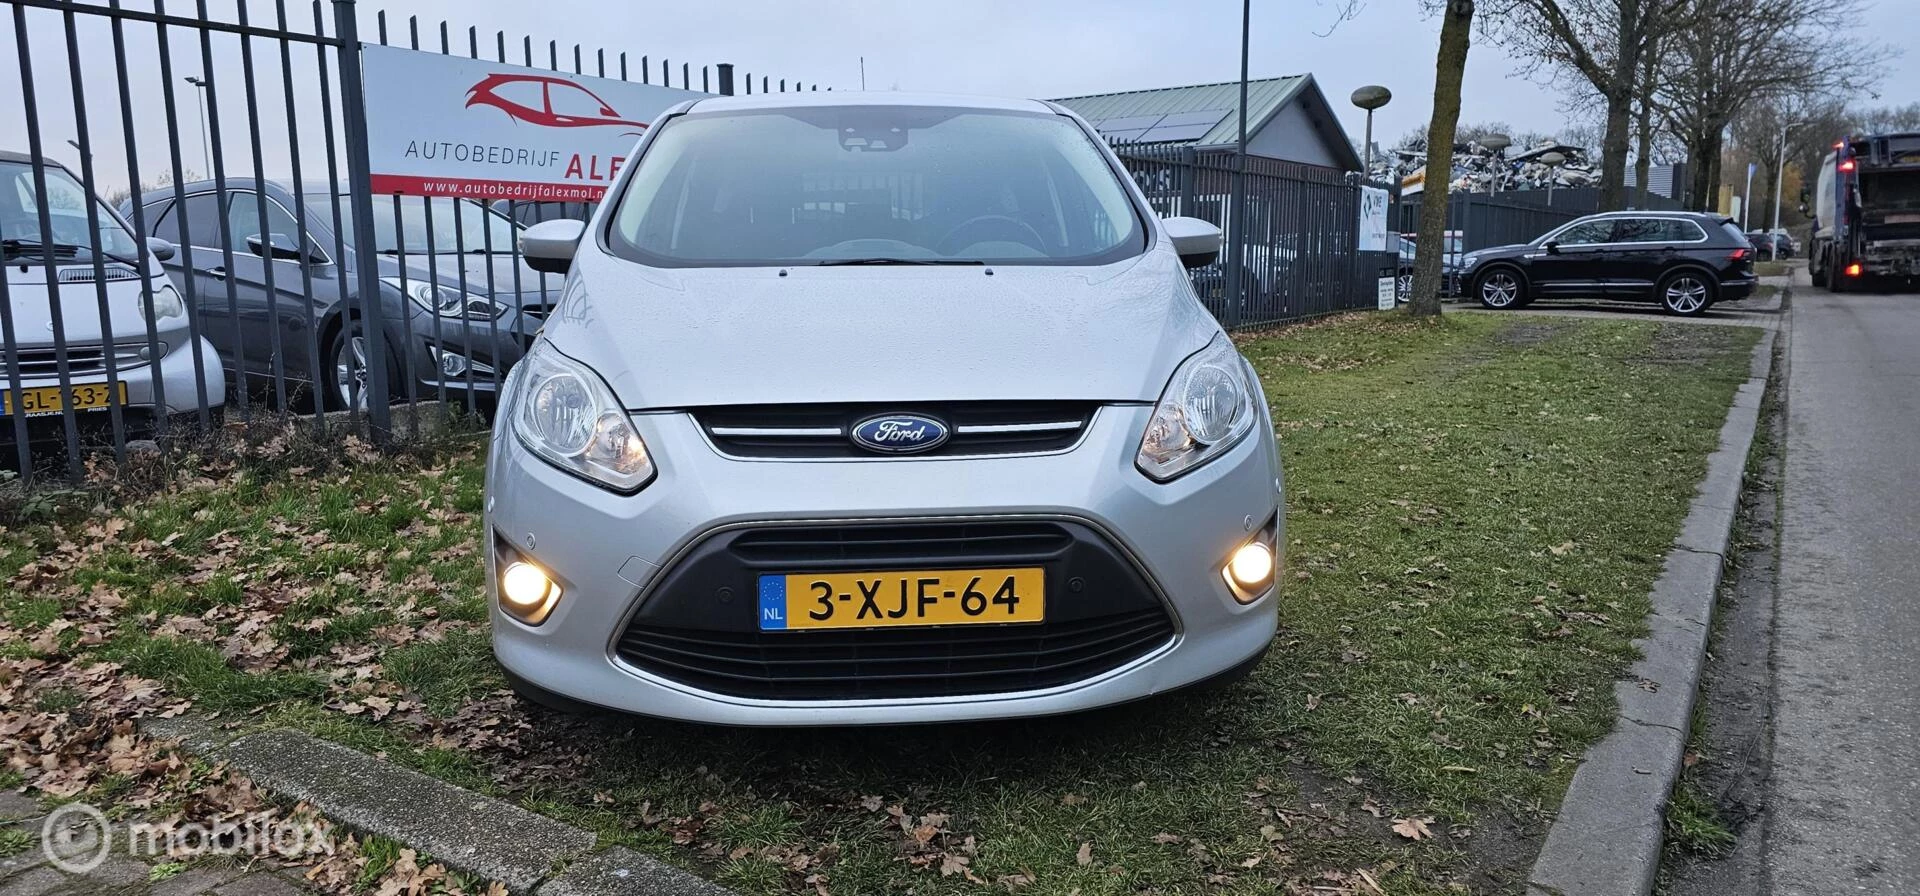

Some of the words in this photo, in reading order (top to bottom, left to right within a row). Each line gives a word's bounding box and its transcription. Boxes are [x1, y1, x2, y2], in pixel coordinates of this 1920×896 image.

[405, 140, 560, 167] AUTOBEDRIJF
[423, 181, 606, 199] www.autobedrijfalexmol.n
[22, 386, 111, 410] GL-63-Z
[874, 420, 926, 442] Ford
[764, 607, 783, 621] NL
[809, 576, 1020, 622] 3-XJF-64
